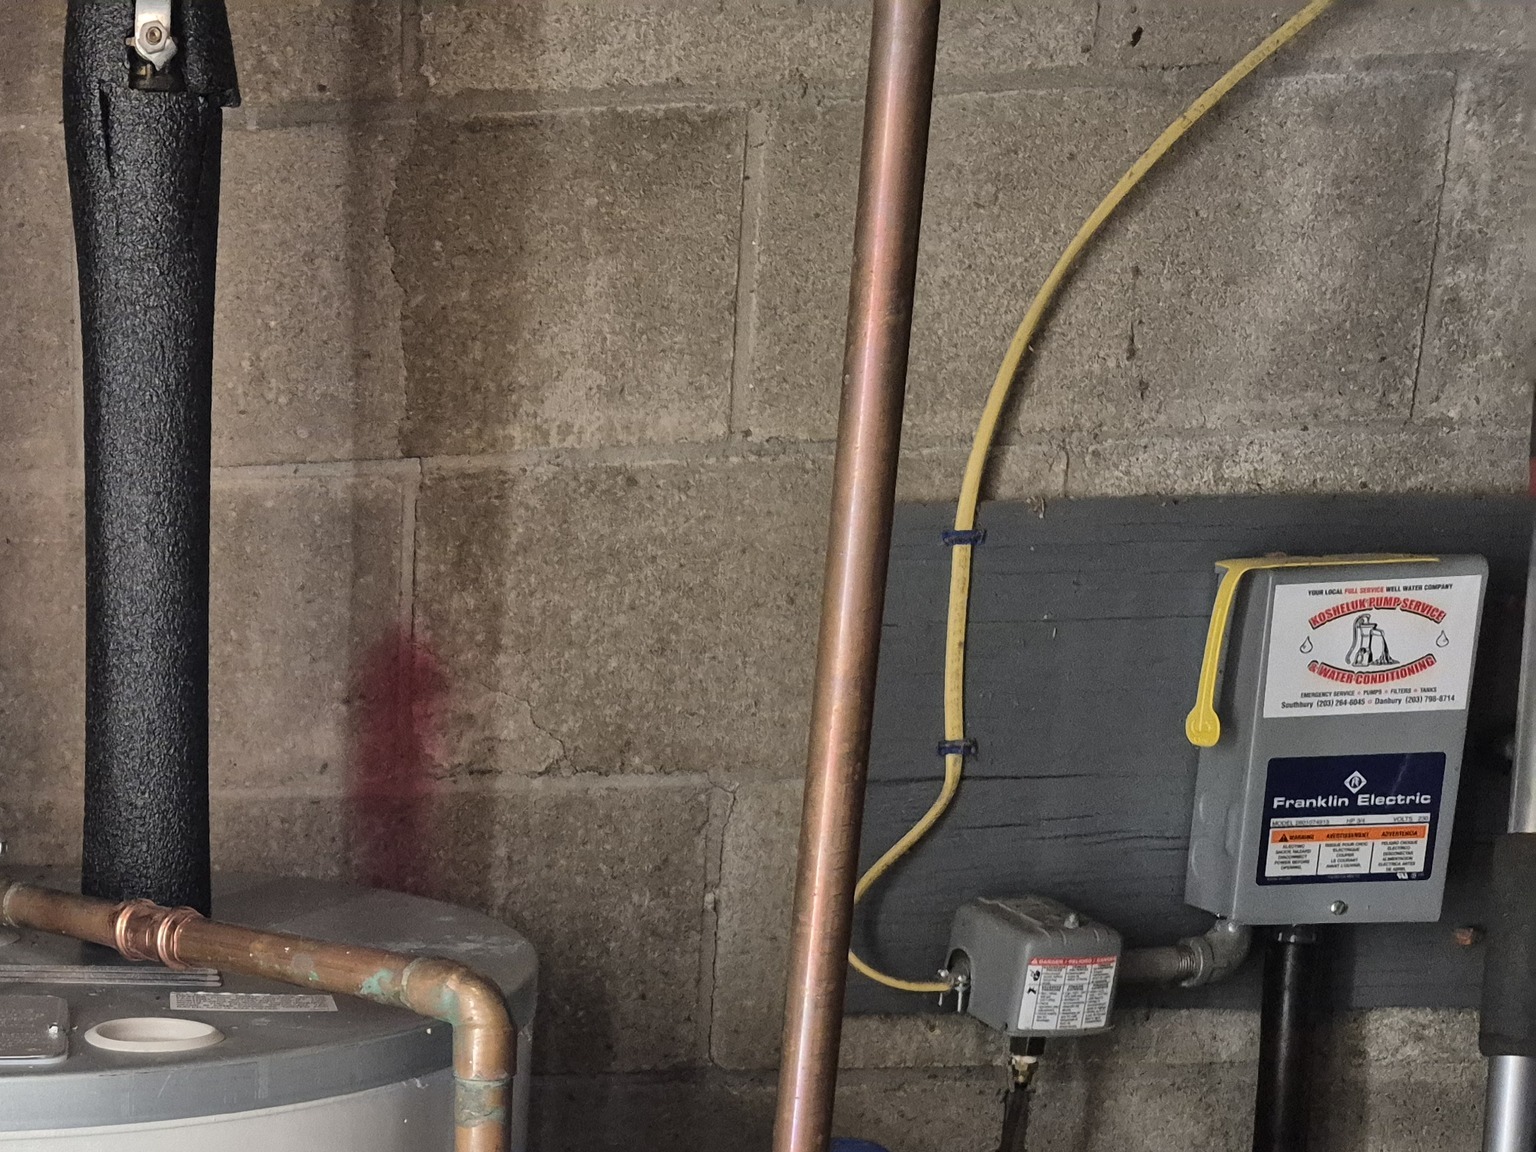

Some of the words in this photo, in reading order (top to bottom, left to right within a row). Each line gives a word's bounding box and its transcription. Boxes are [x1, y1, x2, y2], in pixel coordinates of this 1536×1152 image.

[1360, 586, 1384, 594] SERVICE
[1424, 583, 1453, 591] COMPANY
[1309, 597, 1369, 630] KOSHELUK
[1368, 596, 1401, 610] PUMP
[1400, 598, 1447, 625] SERVICE
[1318, 662, 1355, 685] WATER
[1355, 653, 1437, 685] CONDITIONING
[1300, 691, 1332, 699] EMERGENCY
[1281, 701, 1313, 710] Southbury
[1316, 699, 1334, 708] (203)
[1374, 697, 1402, 706] Danbury
[1405, 696, 1423, 704] (203)
[1272, 795, 1349, 809] Franklin
[1357, 792, 1432, 806] Electric
